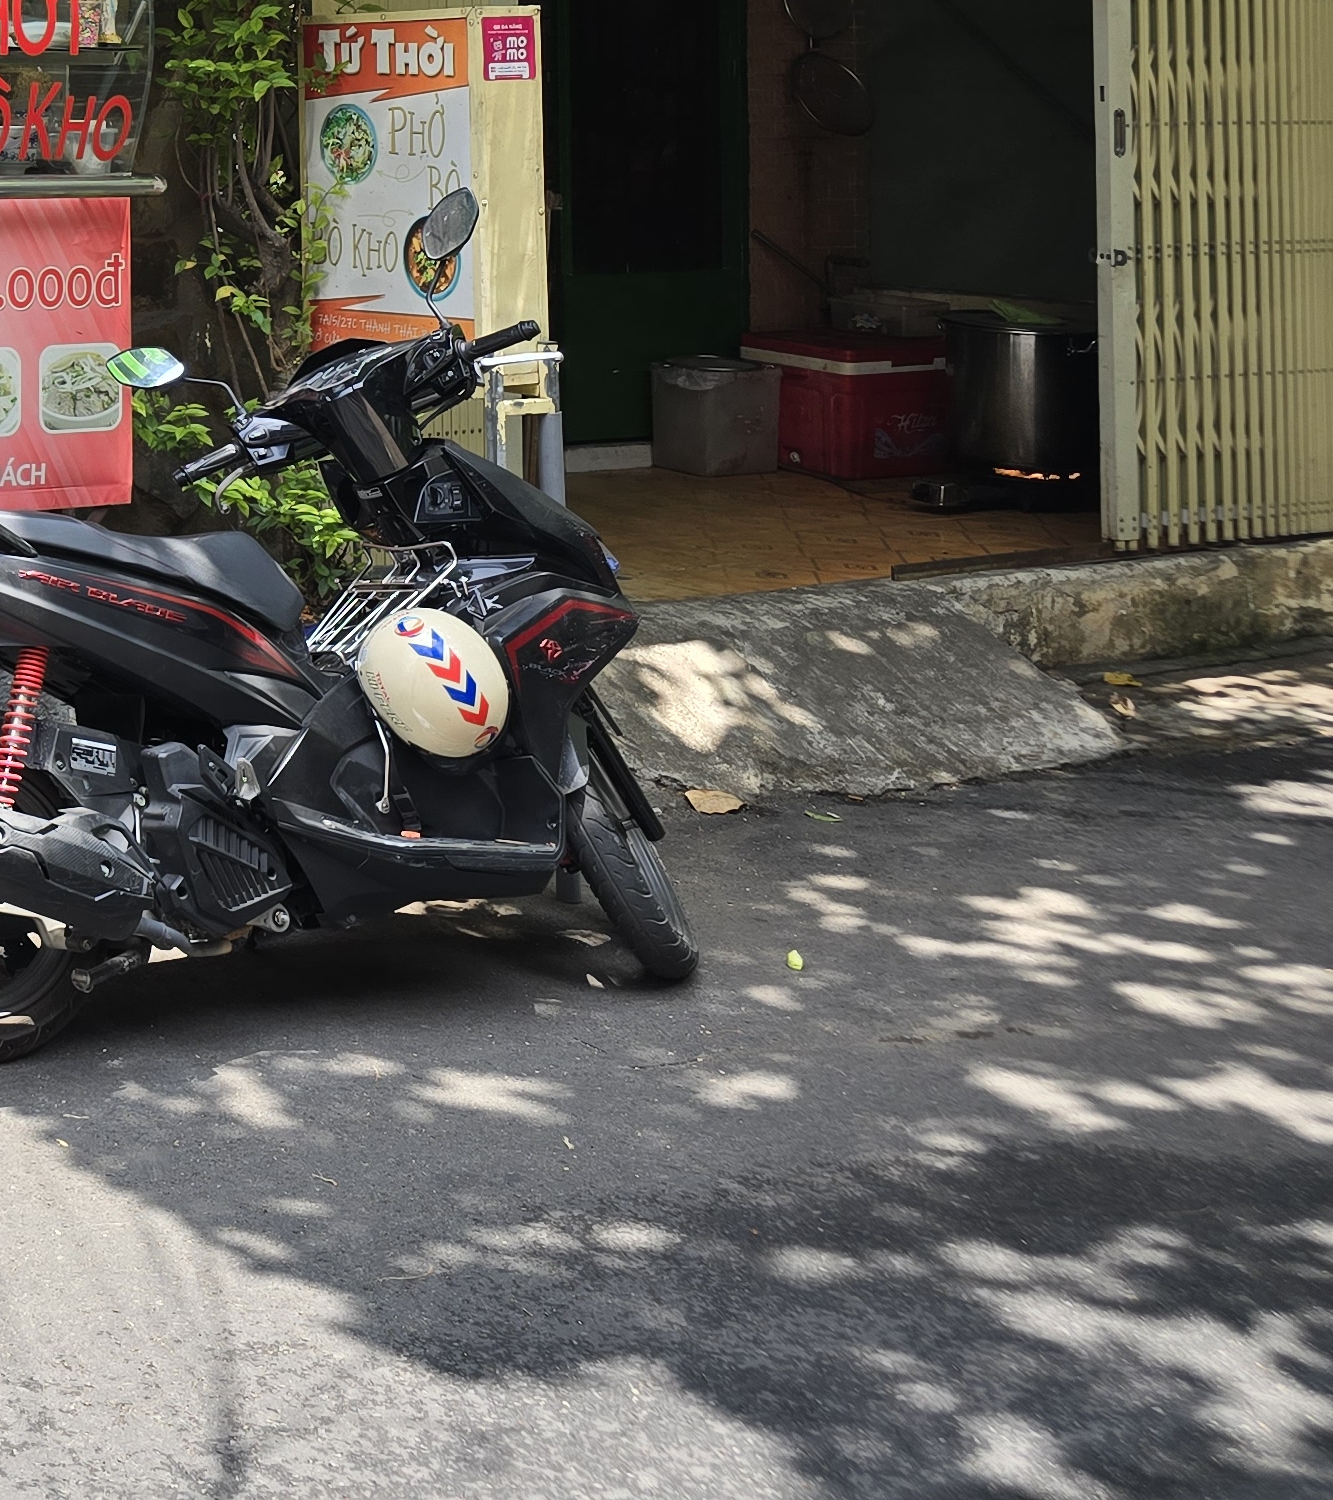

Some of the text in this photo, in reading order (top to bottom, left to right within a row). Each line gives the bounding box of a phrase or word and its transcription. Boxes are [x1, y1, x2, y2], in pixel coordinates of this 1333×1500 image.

[318, 25, 455, 77] TỨ THỜI
[19, 81, 133, 162] KHO
[388, 93, 445, 158] PHỞ
[352, 224, 399, 277] KHO
